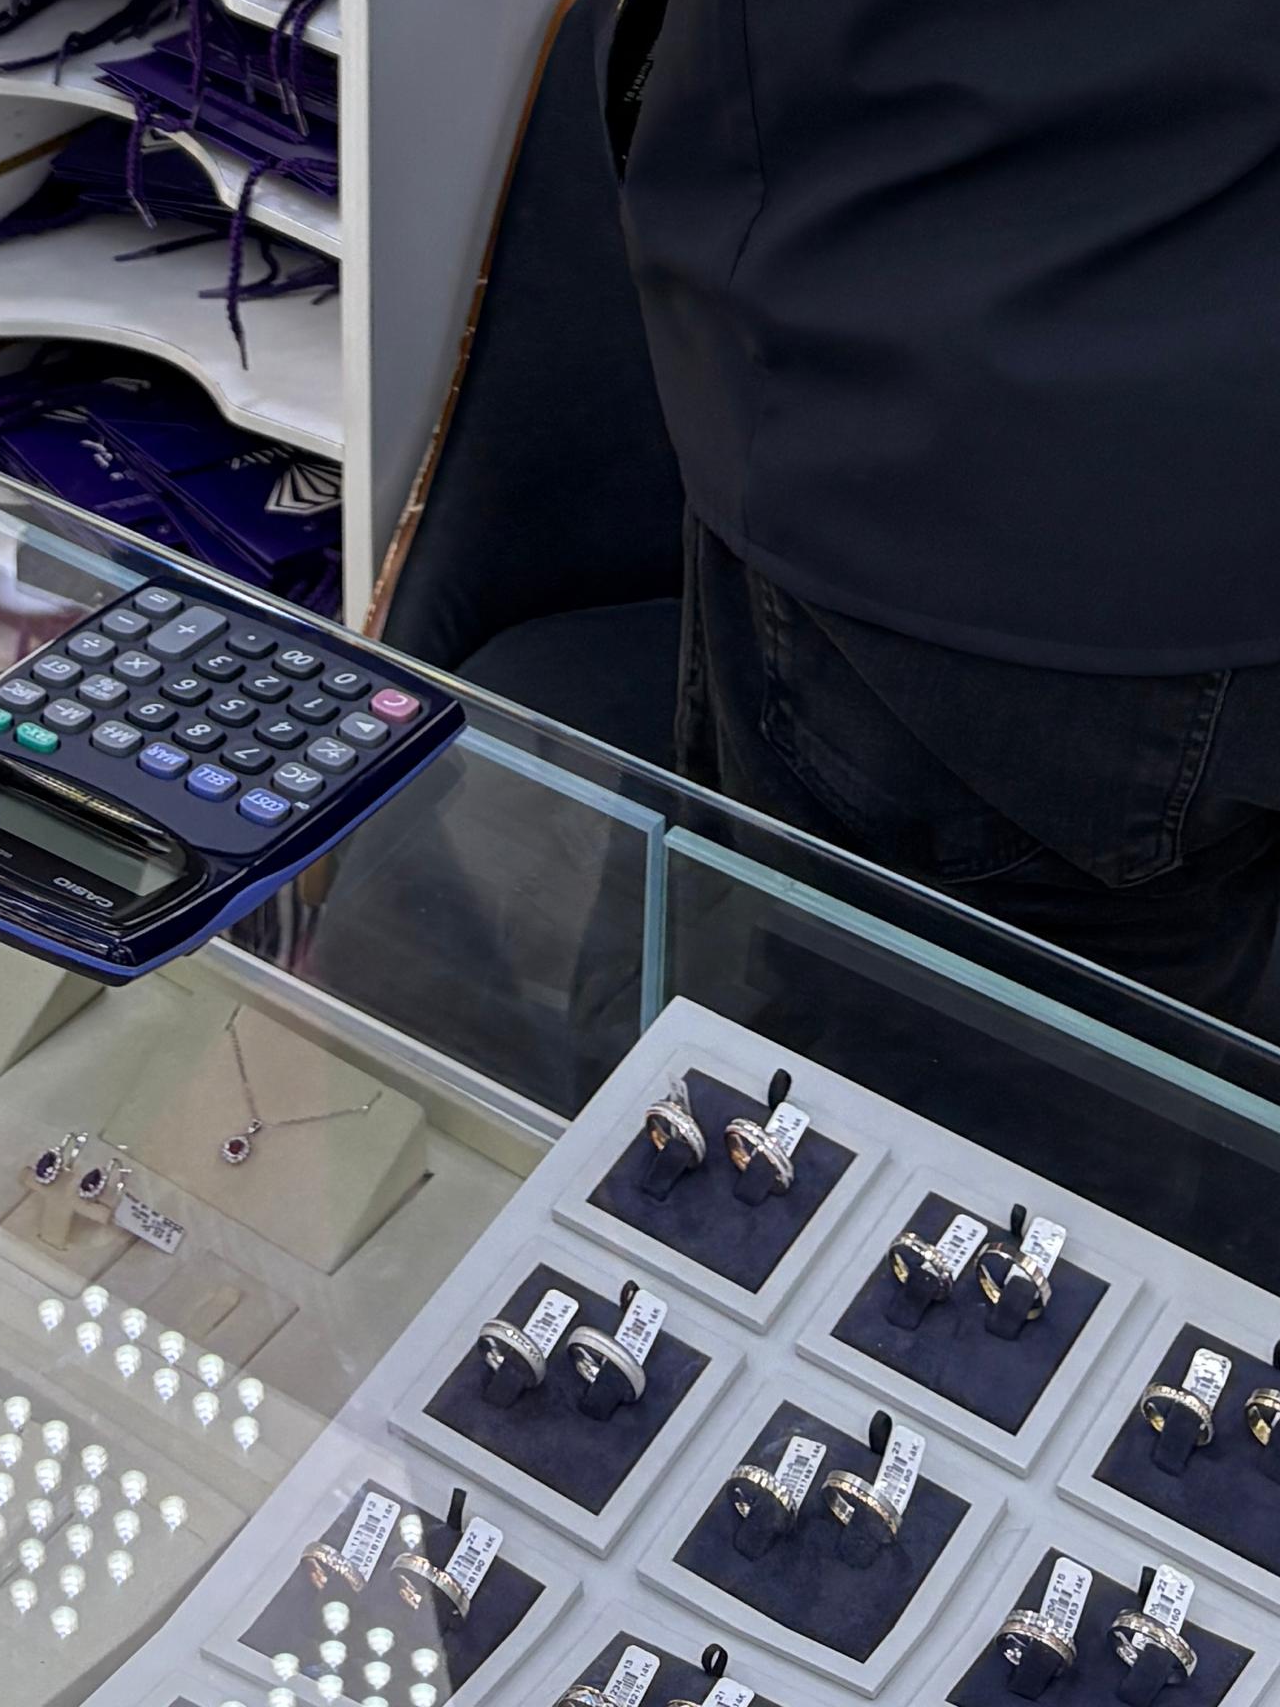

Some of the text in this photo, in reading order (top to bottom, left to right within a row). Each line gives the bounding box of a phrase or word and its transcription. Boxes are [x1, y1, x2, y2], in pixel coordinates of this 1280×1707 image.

[208, 655, 233, 667] 3
[281, 650, 314, 665] 00
[41, 660, 71, 673] GT
[172, 679, 198, 690] 6
[254, 675, 280, 687] 2
[333, 673, 358, 684] 0
[220, 700, 246, 711] 5
[303, 698, 324, 709] 1
[382, 692, 409, 708] C
[139, 703, 165, 715] 9
[186, 723, 212, 736] 8
[269, 721, 293, 733] 4
[234, 748, 261, 759] 7
[196, 767, 232, 786] SELL
[280, 767, 317, 784] AC
[246, 792, 285, 812] COST
[54, 876, 114, 909] CASIO
[558, 1303, 573, 1320] 14K
[648, 1308, 661, 1325] 14K
[890, 1440, 904, 1455] 23
[905, 1442, 921, 1462] 14K
[381, 1502, 396, 1521] 14K
[465, 1531, 478, 1546] 22
[481, 1535, 496, 1554] 14K
[1071, 1575, 1088, 1595] 14K
[1156, 1578, 1169, 1593] 22
[1173, 1582, 1189, 1602] 14K
[622, 1658, 634, 1670] 13
[638, 1661, 653, 1678] 14K
[714, 1689, 727, 1702] 21
[732, 1692, 746, 1707] 14K
